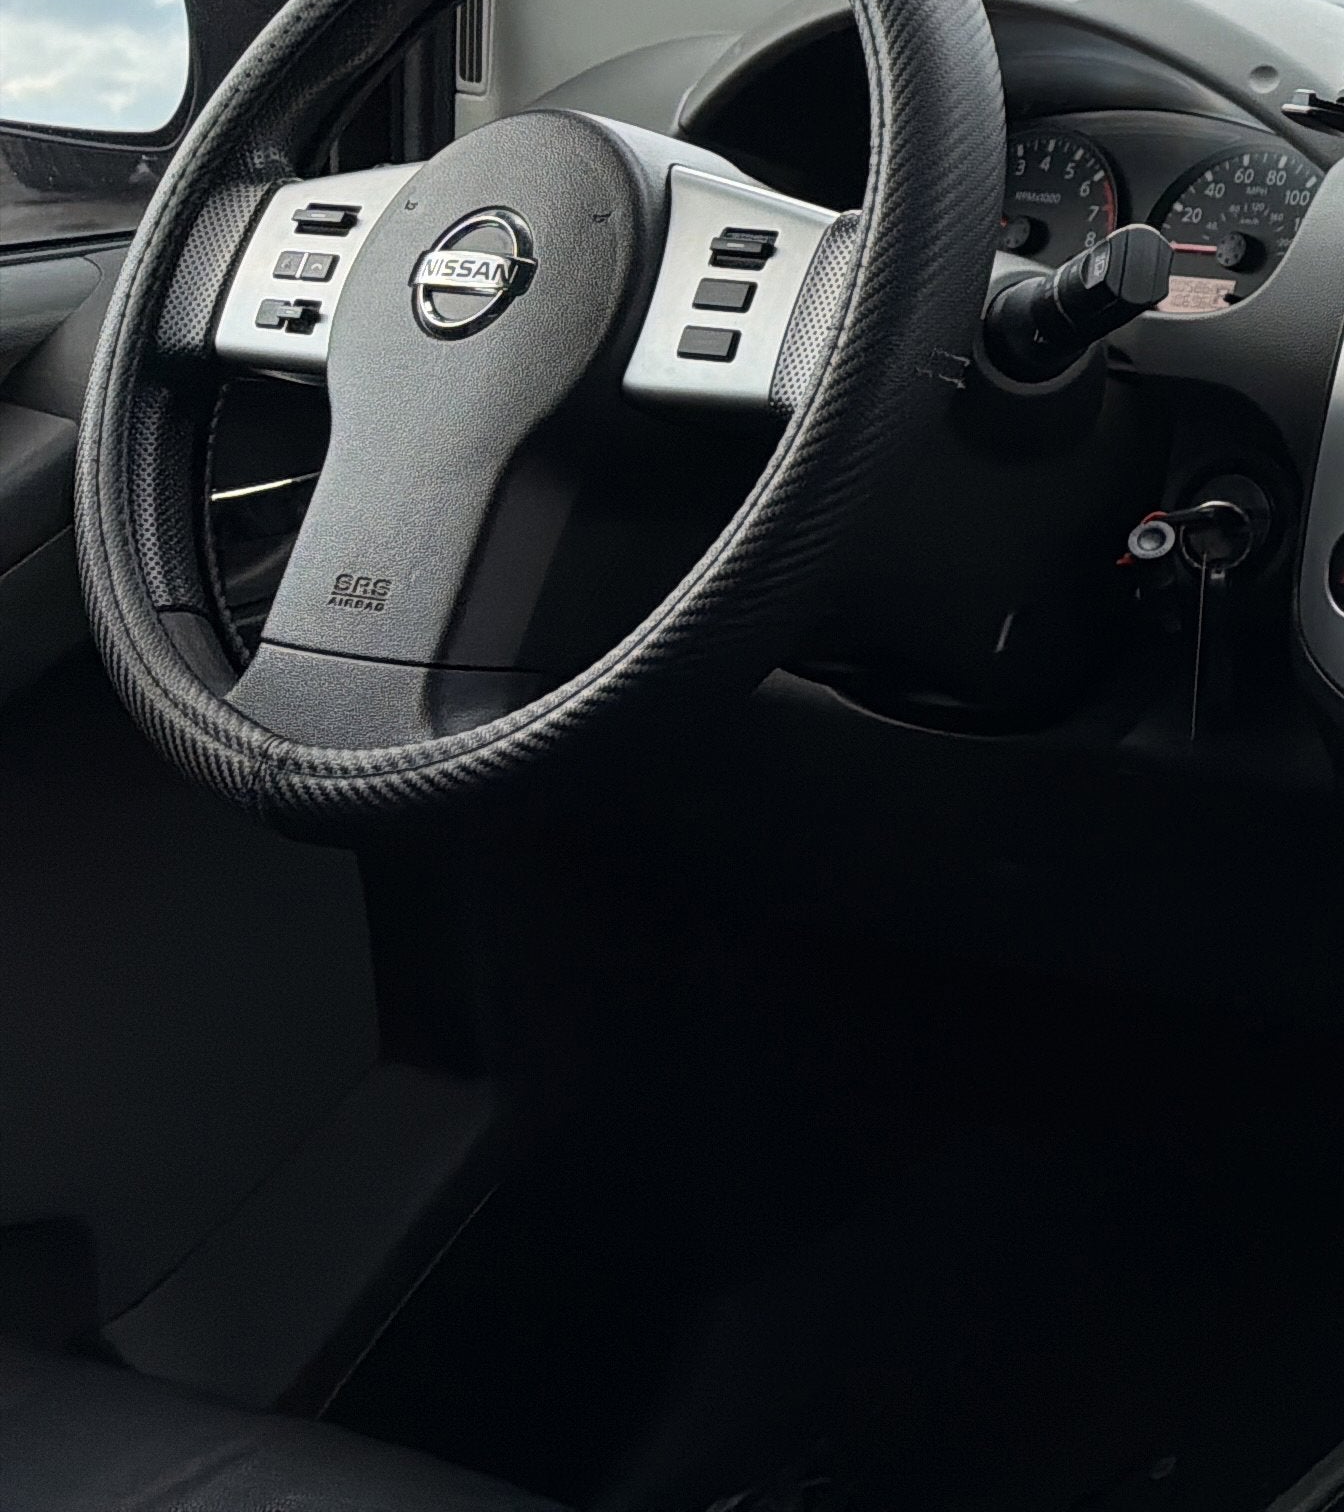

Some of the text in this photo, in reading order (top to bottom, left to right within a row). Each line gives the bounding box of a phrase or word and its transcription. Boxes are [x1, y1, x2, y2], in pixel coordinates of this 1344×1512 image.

[1015, 159, 1026, 176] 3
[1040, 155, 1051, 172] 4
[1064, 162, 1077, 179] 5
[1234, 168, 1254, 184] 60
[1266, 170, 1287, 186] 80
[1080, 180, 1090, 197] 6
[1204, 183, 1226, 198] 40
[1284, 190, 1310, 206] 100
[1088, 205, 1100, 221] 7
[1182, 207, 1202, 223] 20
[1084, 231, 1096, 247] 8
[422, 259, 519, 284] NISSAN
[334, 574, 391, 596] SRS
[327, 597, 385, 612] AIRBAG
